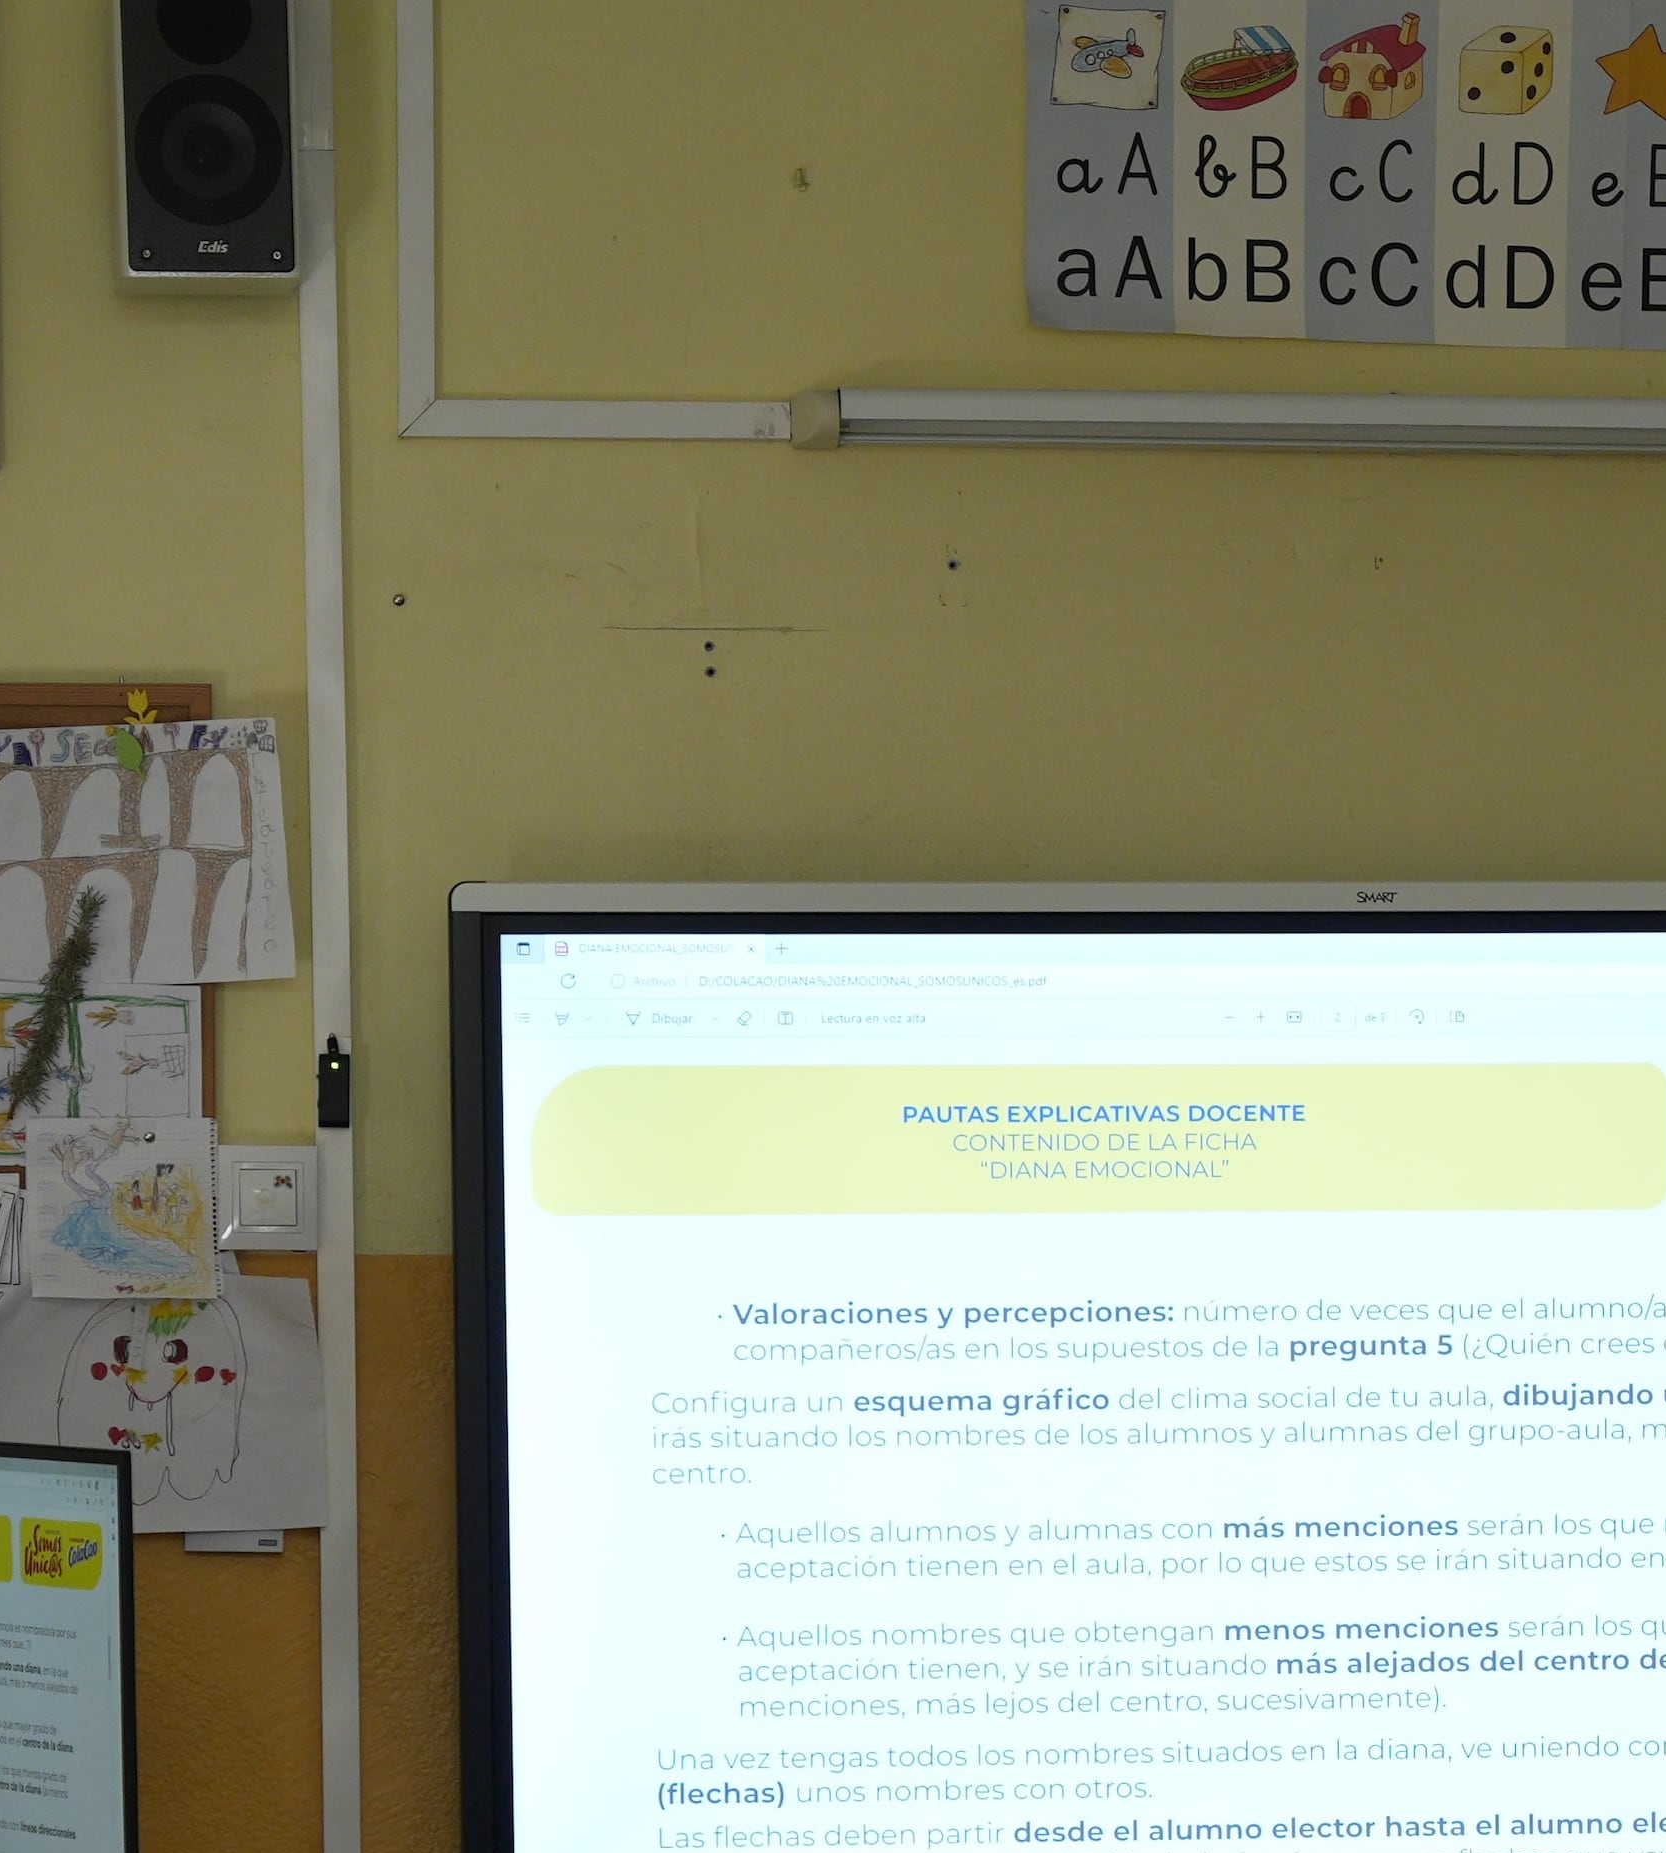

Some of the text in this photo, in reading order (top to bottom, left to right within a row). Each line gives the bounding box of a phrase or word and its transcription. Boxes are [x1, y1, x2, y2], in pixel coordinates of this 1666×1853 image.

[198, 240, 229, 253] Edis
[1356, 891, 1398, 904] SMART
[633, 975, 676, 988] Archivo
[652, 1011, 694, 1027] Dibujar
[821, 1011, 927, 1025] Lectura en voz alta
[903, 1104, 1306, 1124] PAUTAS EXPLICATIVAS DOCENTE
[952, 1132, 1257, 1153] CONTENIDO DE LA FICHA
[732, 1300, 929, 1326] Valoraciones
[936, 1306, 955, 1330] y
[964, 1298, 1175, 1330] percepciones:
[1184, 1299, 1298, 1322] número
[1305, 1298, 1342, 1321] de
[1349, 1303, 1430, 1321] veces
[1437, 1303, 1494, 1326] que
[1501, 1296, 1524, 1320] el
[964, 1342, 1000, 1360] en
[1010, 1336, 1049, 1360] los
[1056, 1338, 1204, 1364] supuestos
[1212, 1335, 1249, 1358] de
[1257, 1334, 1280, 1358] la
[1289, 1335, 1428, 1363] pregunta
[1436, 1333, 1454, 1356] 5
[1580, 1336, 1656, 1355] crees
[33, 1524, 62, 1554] Somos
[735, 1520, 862, 1549] Aquellos
[869, 1519, 997, 1543] alumnos
[1004, 1524, 1020, 1547] y
[1028, 1518, 1154, 1541] alumnas
[1161, 1522, 1214, 1540] con
[1223, 1515, 1286, 1539] más
[1294, 1513, 1459, 1539] menciones
[1467, 1512, 1544, 1537] serán
[1553, 1512, 1592, 1536] los
[1600, 1517, 1655, 1540] que
[736, 1623, 863, 1653] Aquellos
[872, 1622, 1002, 1646] nombres
[1010, 1626, 1066, 1649] que
[1074, 1619, 1214, 1648] obtengan
[1224, 1623, 1327, 1641] menos
[1335, 1615, 1500, 1640] menciones
[1508, 1615, 1585, 1638] serán
[1594, 1613, 1633, 1637] los
[657, 1748, 715, 1771] Una
[723, 1752, 771, 1770] vez
[778, 1748, 879, 1774] tengas
[886, 1743, 968, 1768] todos
[977, 1743, 1016, 1767] los
[1025, 1741, 1154, 1766] nombres
[1161, 1739, 1283, 1764] situados
[1291, 1744, 1326, 1762] en
[1336, 1737, 1358, 1761] la
[1367, 1737, 1453, 1764] diana,
[1460, 1742, 1493, 1759] ve
[1502, 1734, 1620, 1759] uniendo
